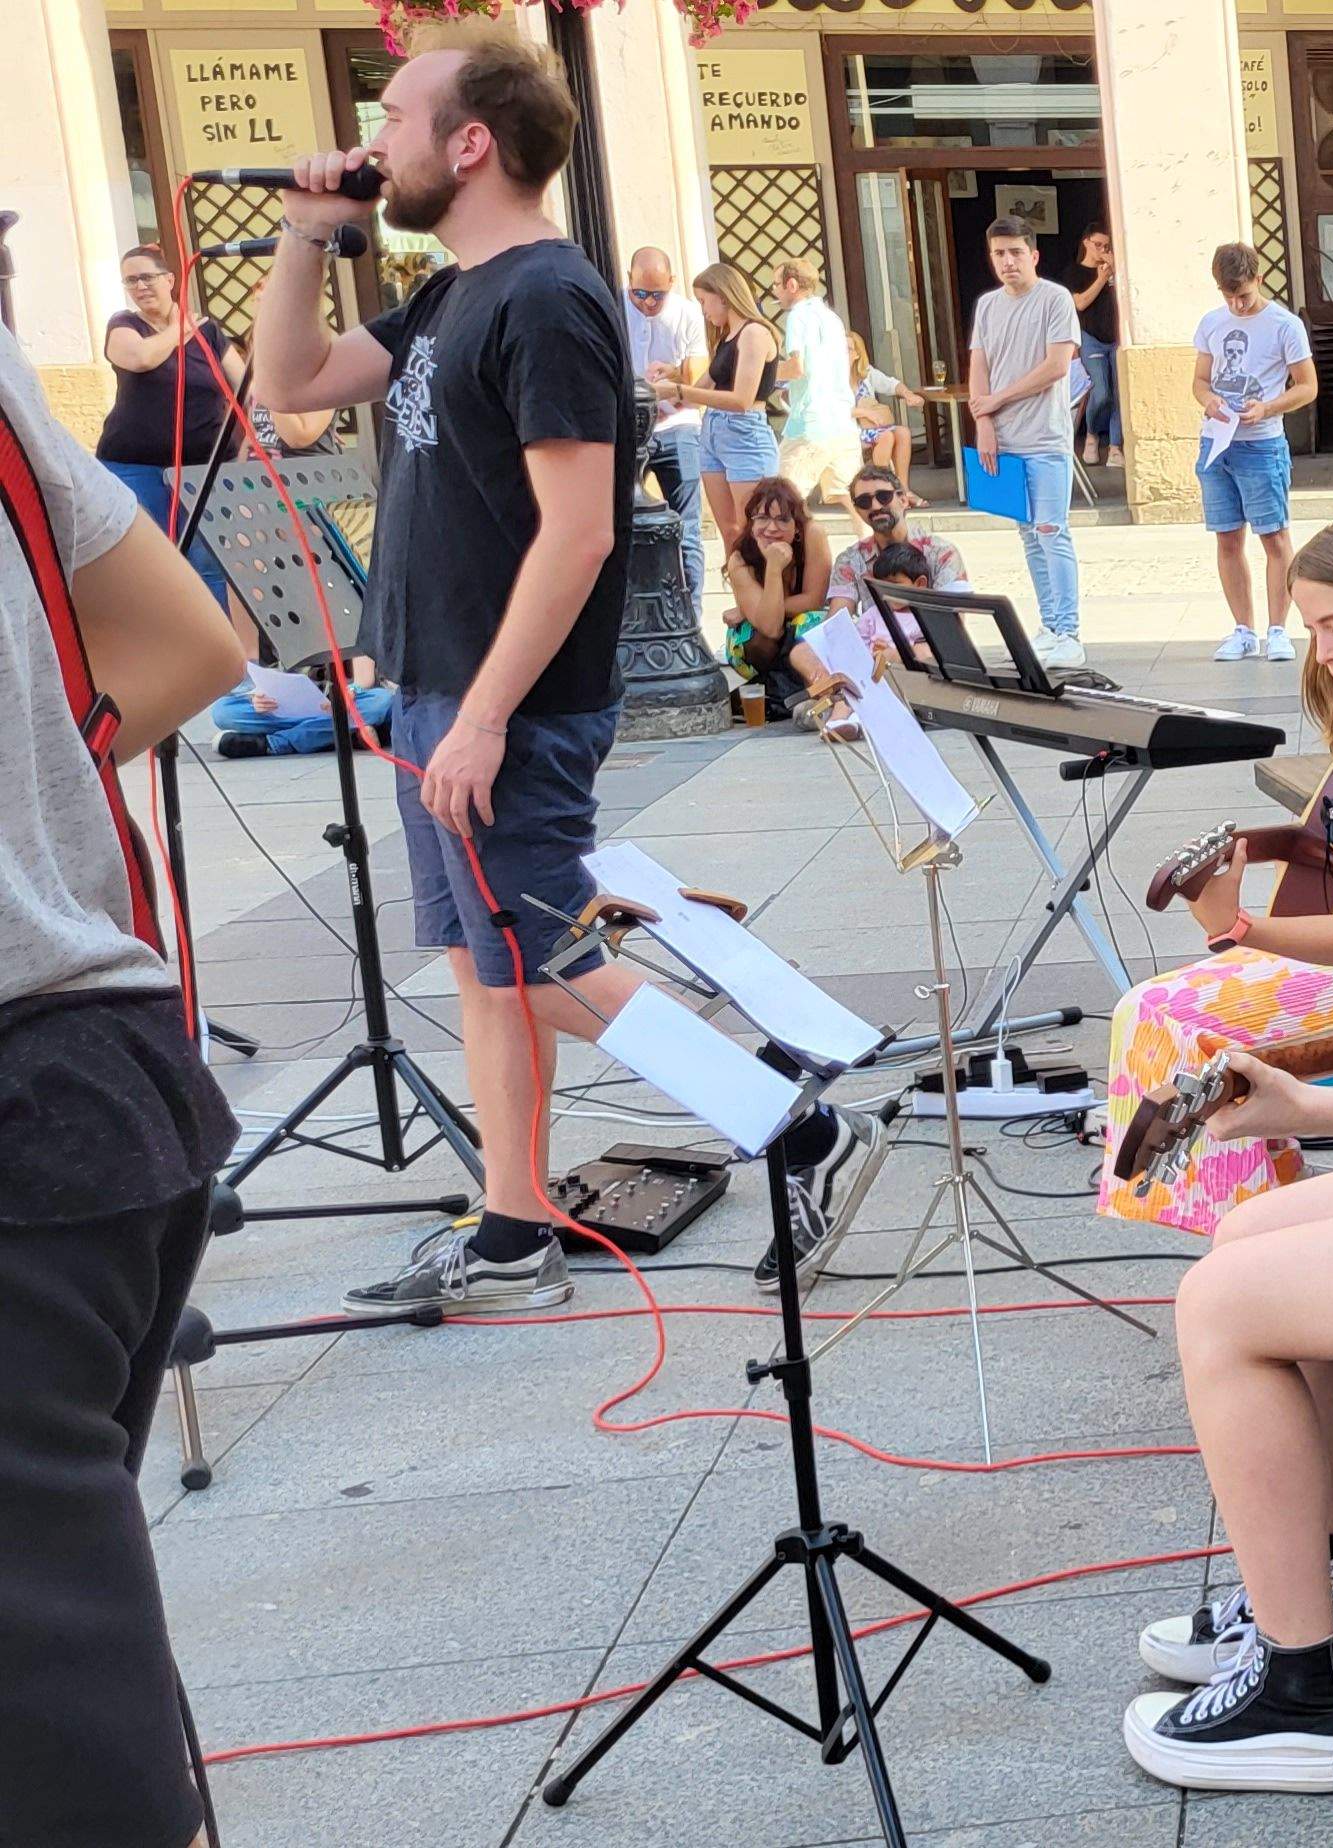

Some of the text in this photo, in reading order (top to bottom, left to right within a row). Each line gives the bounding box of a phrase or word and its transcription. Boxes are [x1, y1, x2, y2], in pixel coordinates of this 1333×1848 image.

[186, 57, 298, 82] LLÁMAME
[697, 63, 721, 80] TE
[200, 94, 256, 112] PERO
[703, 91, 807, 108] RECUERDO
[202, 117, 283, 143] SIN LL
[711, 112, 800, 131] AMANDO
